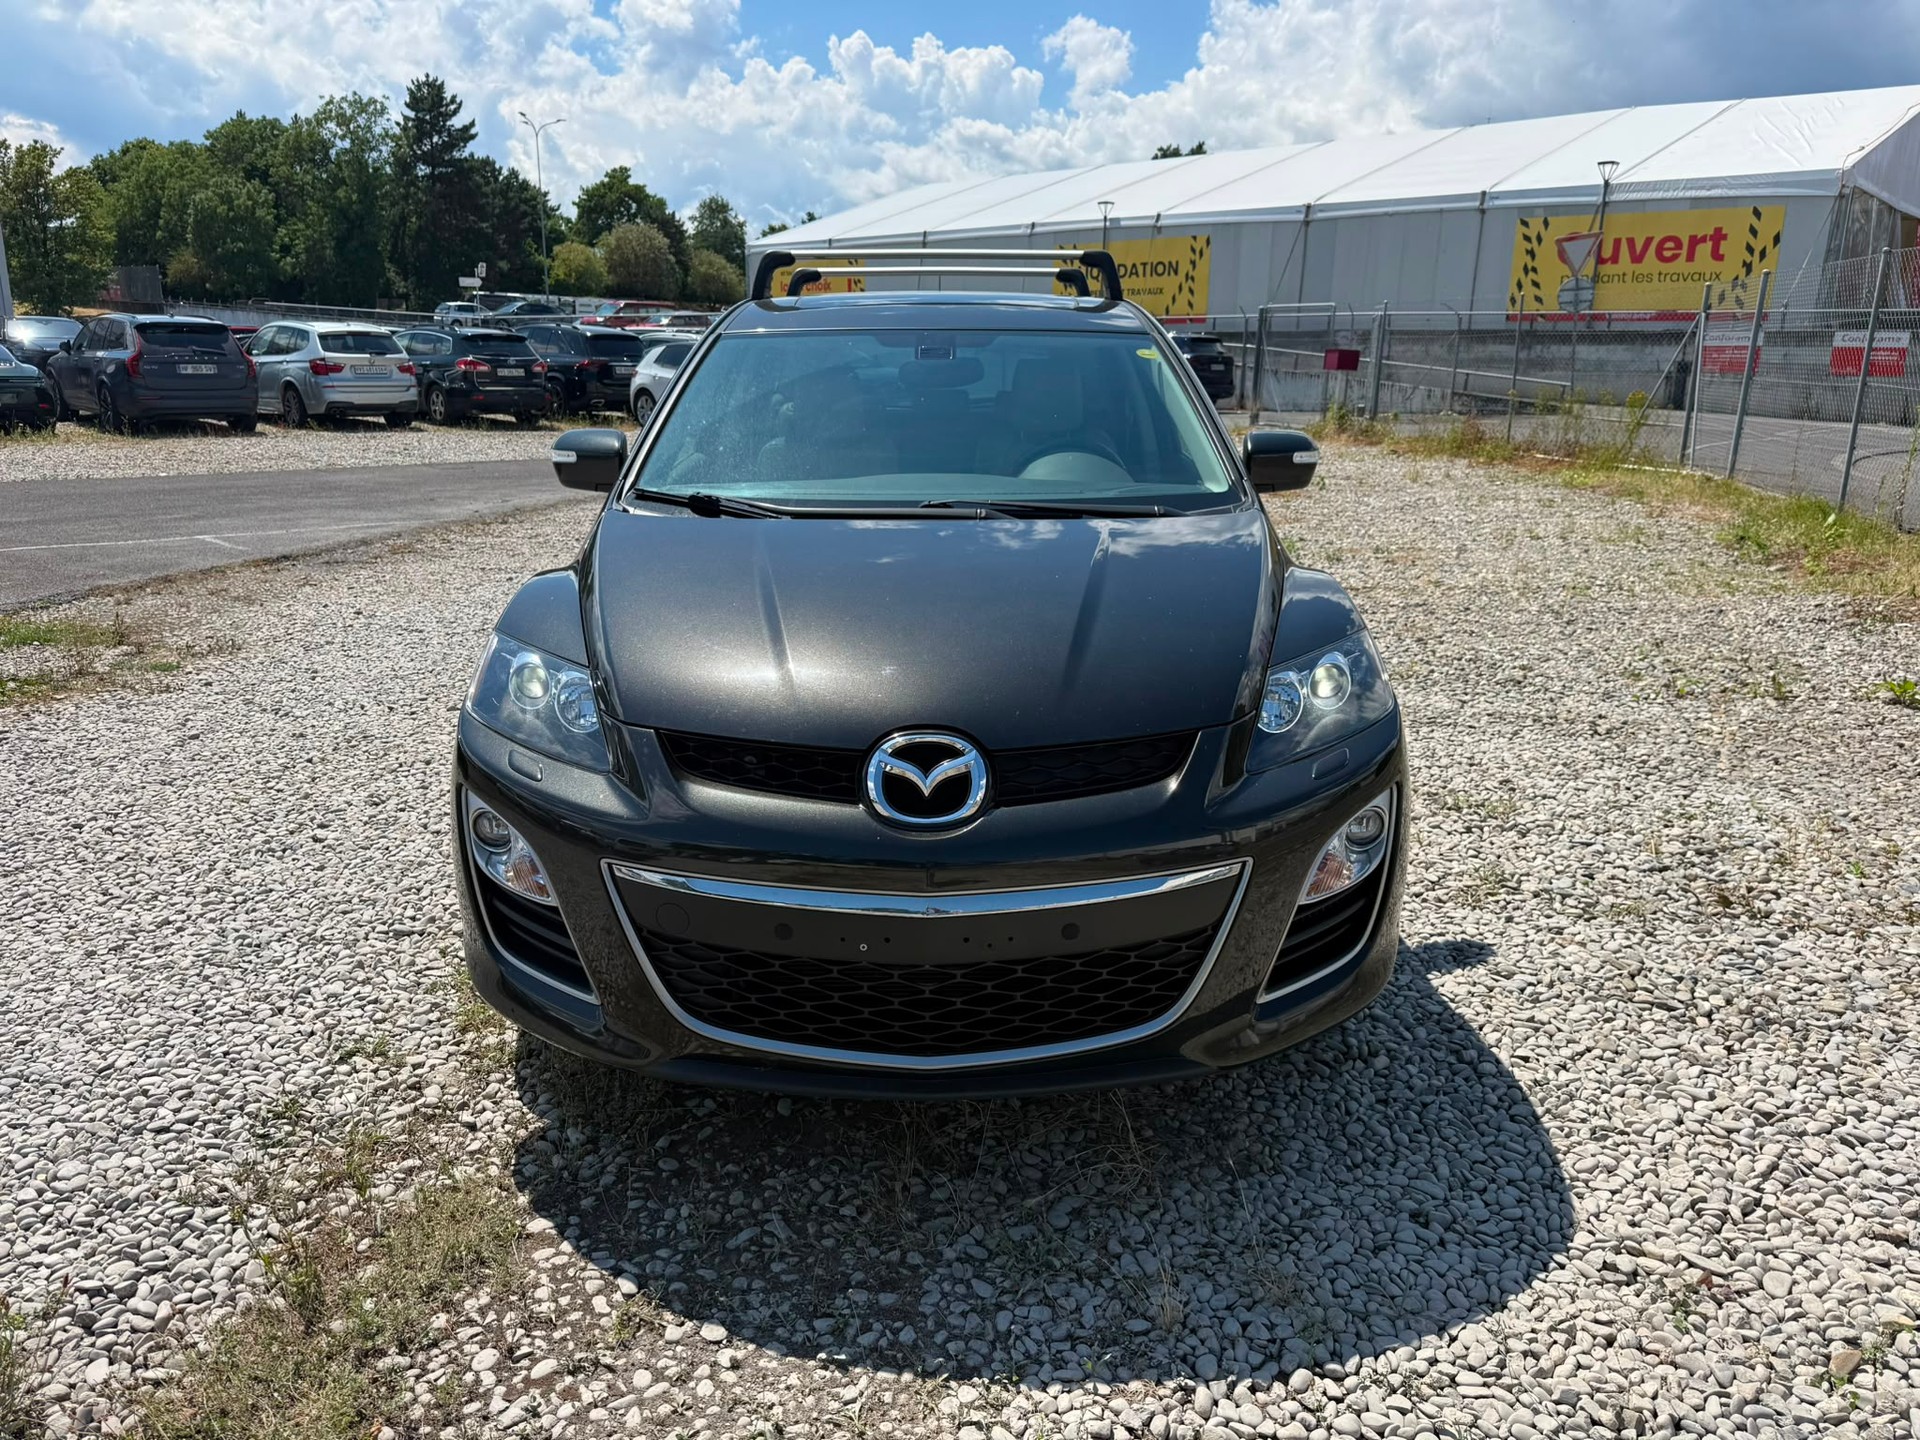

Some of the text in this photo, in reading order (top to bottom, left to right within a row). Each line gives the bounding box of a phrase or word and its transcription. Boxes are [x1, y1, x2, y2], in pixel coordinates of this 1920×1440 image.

[1557, 226, 1728, 266] uvert
[1077, 260, 1180, 282] IQDATION
[1560, 270, 1723, 284] pnant les travaux
[1126, 287, 1165, 297] TRAVAUX
[1703, 333, 1752, 342] Conforam
[1841, 333, 1902, 344] Conframa
